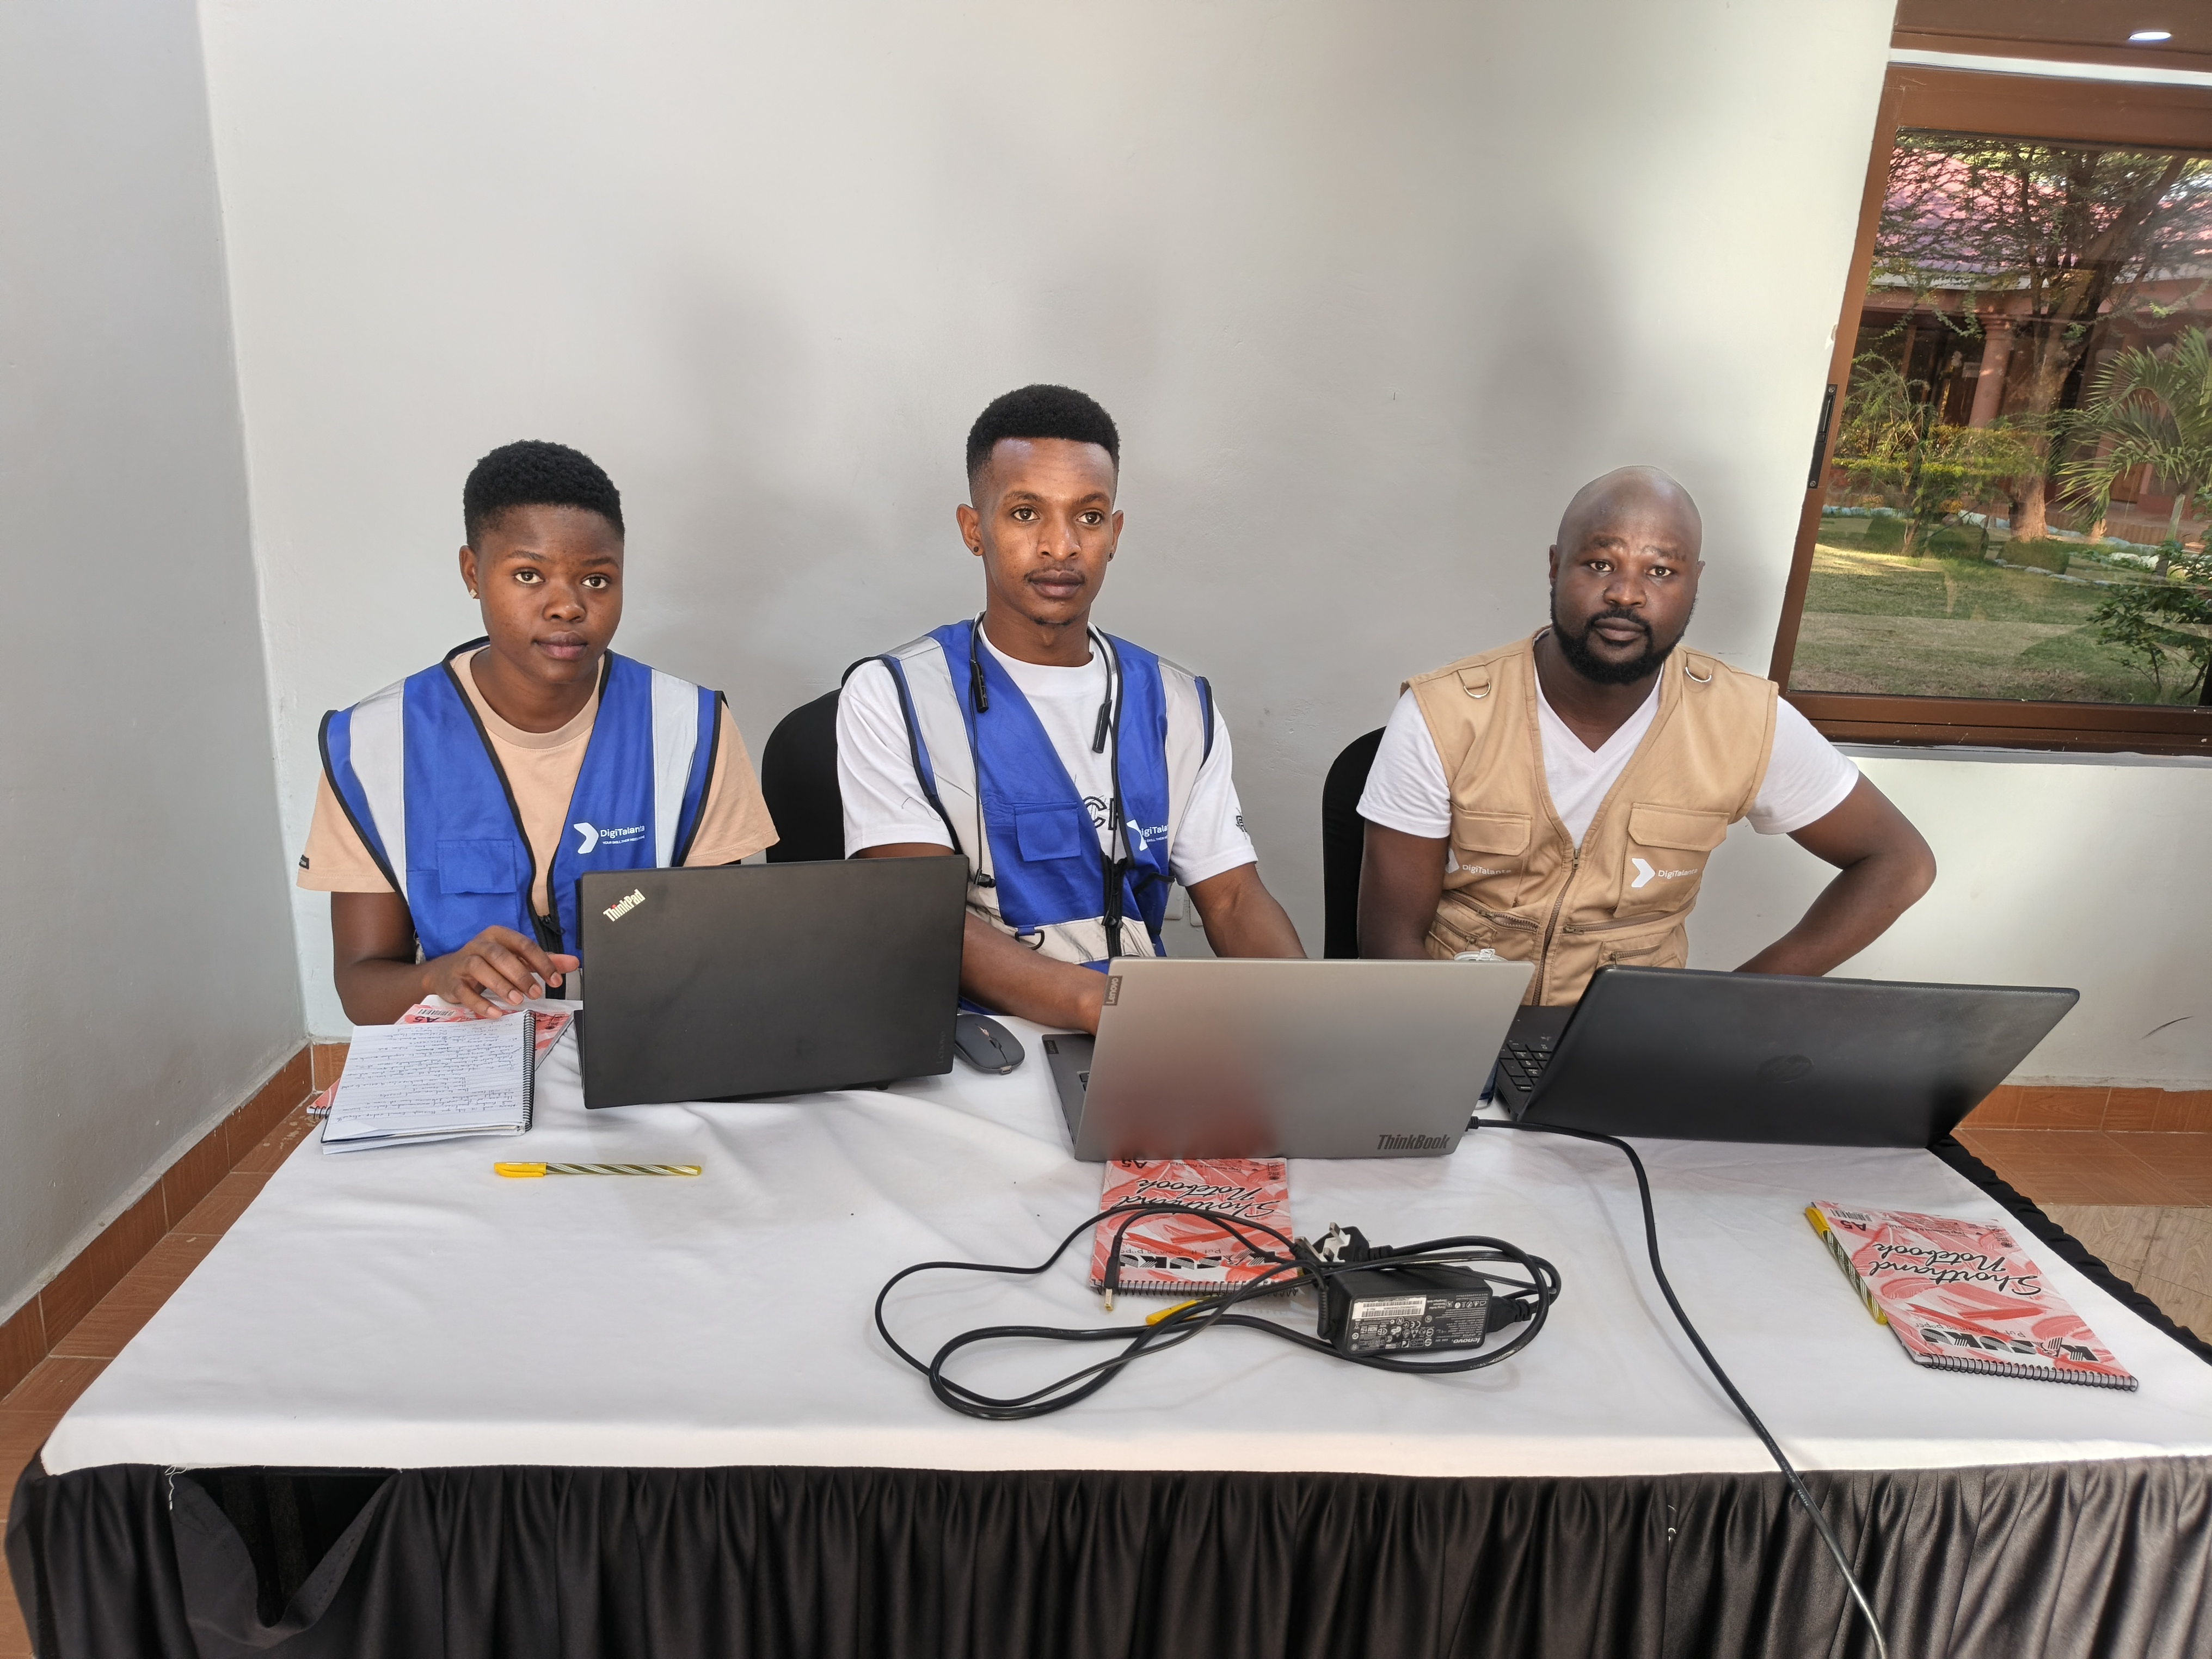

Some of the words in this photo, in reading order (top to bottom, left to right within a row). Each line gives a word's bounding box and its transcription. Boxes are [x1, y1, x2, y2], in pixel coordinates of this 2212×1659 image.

[600, 825, 645, 839] DigiTalanta
[1141, 825, 1168, 837] igiTala
[1462, 864, 1511, 875] DigiTalanta
[1658, 869, 1698, 879] DigiTalanta
[603, 888, 646, 922] ThinkPad
[1105, 978, 1119, 1004] Lenovo
[1377, 1134, 1451, 1150] ThinkBook
[1121, 1159, 1148, 1169] A5
[1135, 1179, 1263, 1201] Notebook
[1840, 1220, 1866, 1231] A5
[1872, 1244, 2006, 1272] Notebook
[1868, 1261, 2042, 1295] Shorthand
